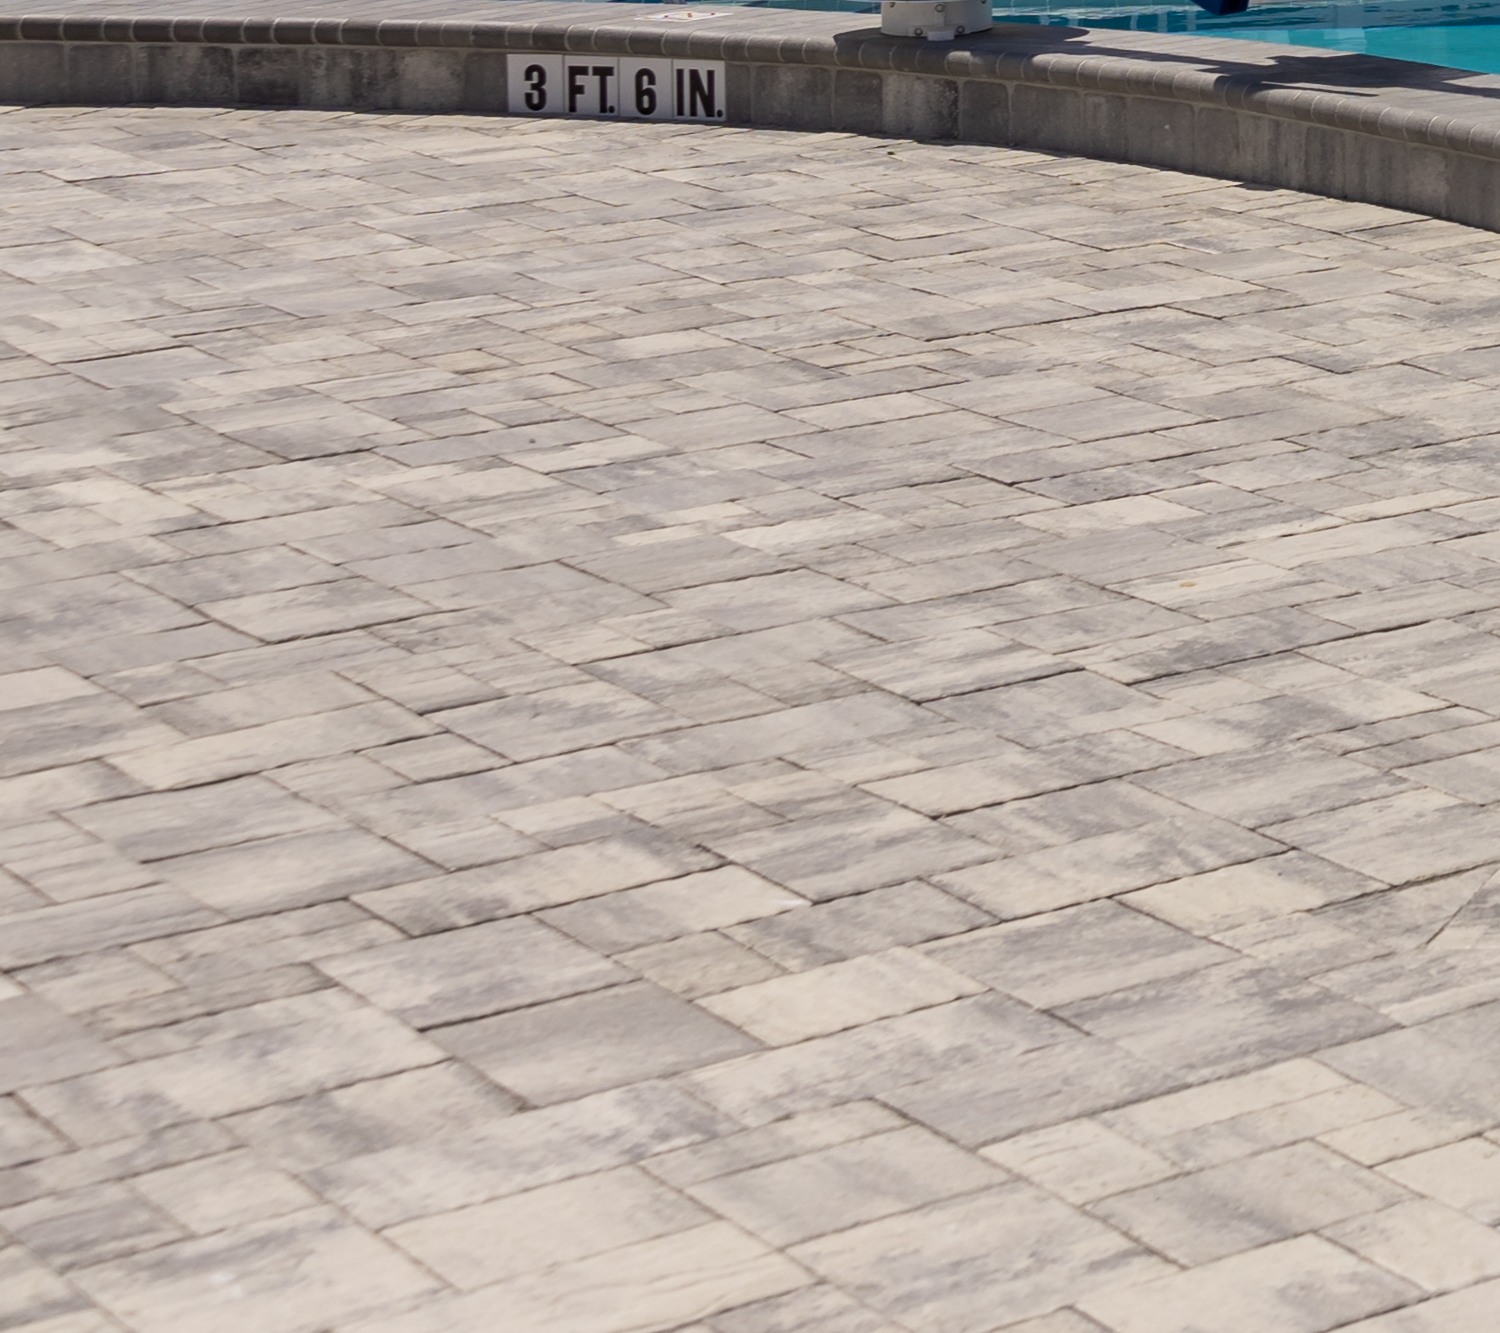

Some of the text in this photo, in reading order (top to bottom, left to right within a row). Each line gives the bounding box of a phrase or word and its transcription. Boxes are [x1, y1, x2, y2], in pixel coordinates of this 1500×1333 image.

[524, 64, 724, 118] 3 FT. 6 IN.
